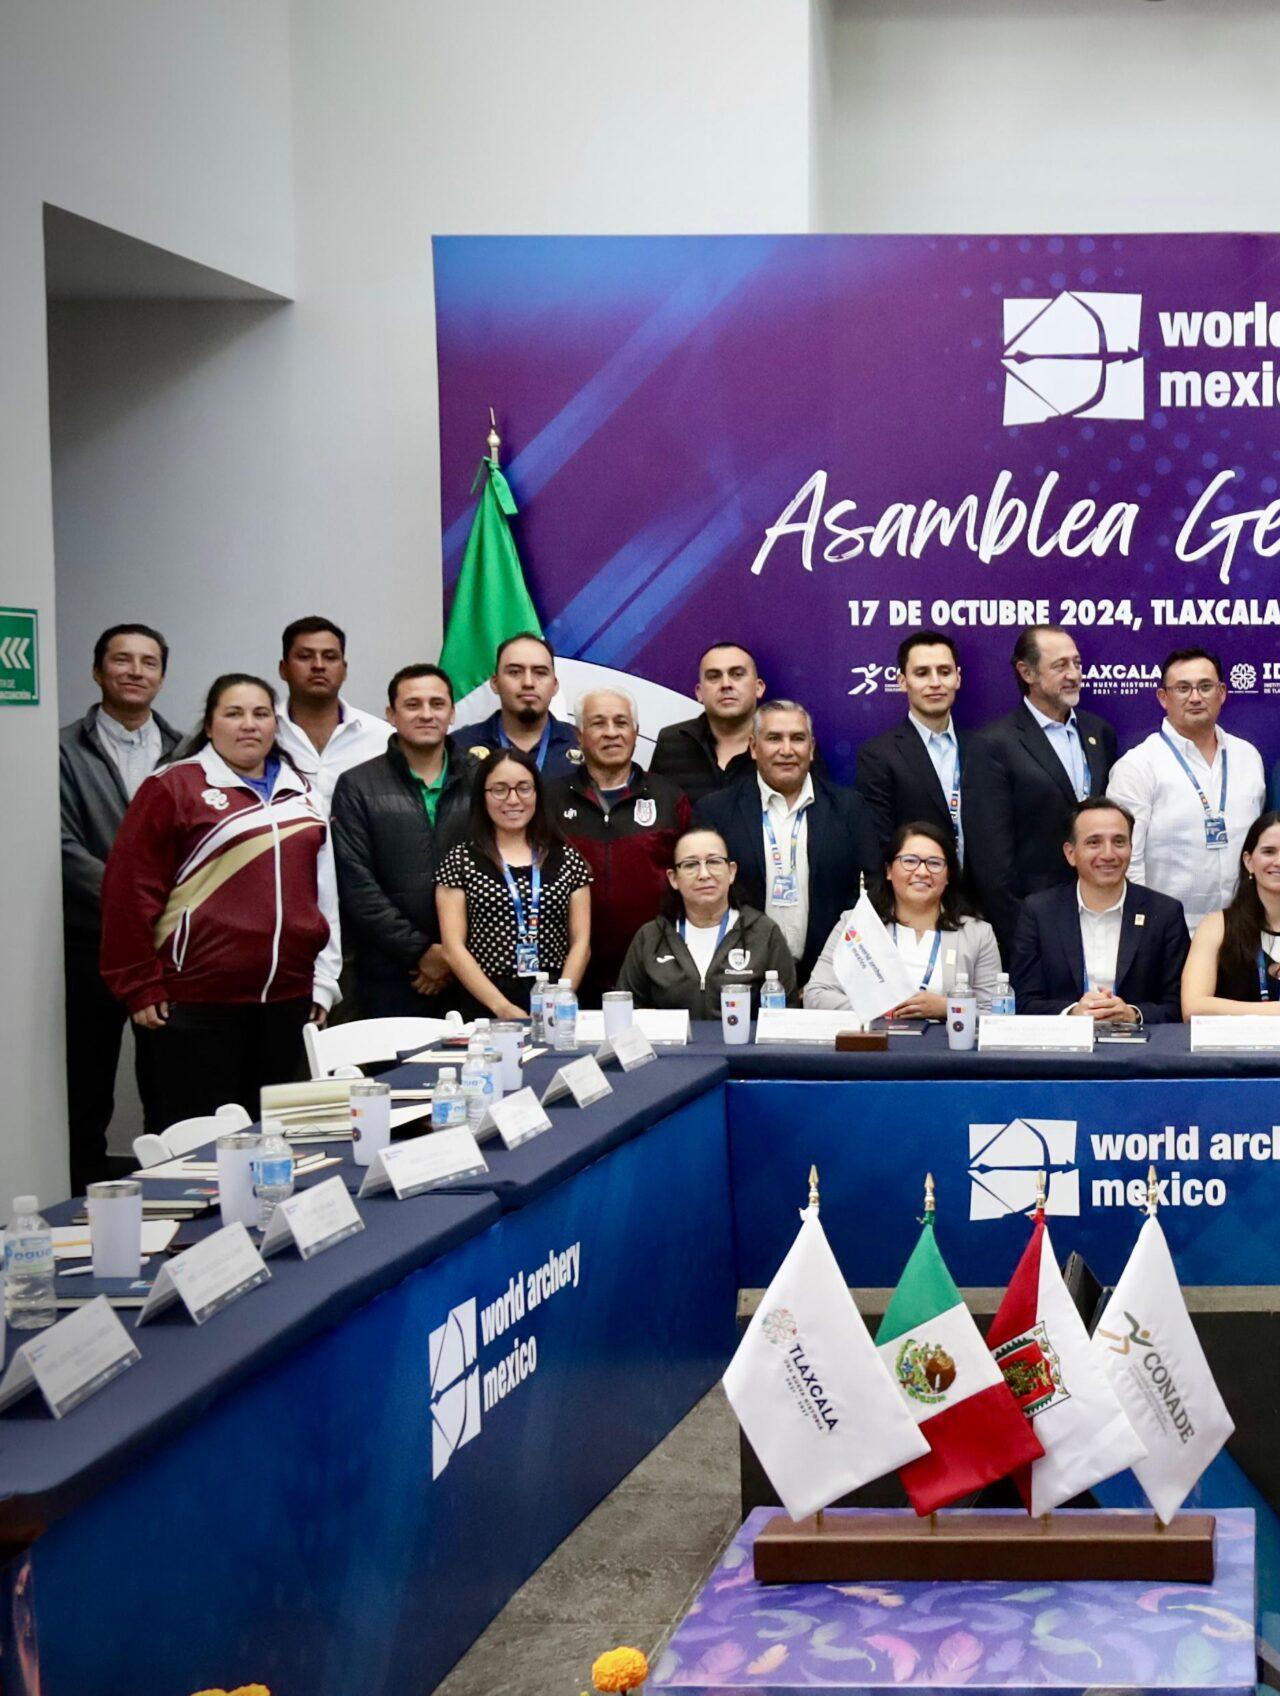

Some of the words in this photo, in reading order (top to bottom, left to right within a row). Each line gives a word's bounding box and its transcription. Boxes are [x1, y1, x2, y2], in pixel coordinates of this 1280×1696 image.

[750, 469, 1140, 576] Asamblea
[848, 600, 880, 626] 17
[889, 600, 922, 626] DE
[930, 599, 1050, 626] OCTUBRE
[1059, 599, 1144, 632] 2024,
[1079, 664, 1163, 680] LAXCALA
[1090, 1126, 1200, 1161] world
[1091, 1171, 1227, 1207] mexico
[480, 1269, 526, 1347] world
[526, 1241, 581, 1312] archery
[482, 1335, 538, 1413] mexico
[789, 1343, 839, 1431] TLAXCALA
[1143, 1352, 1196, 1445] CONADE
